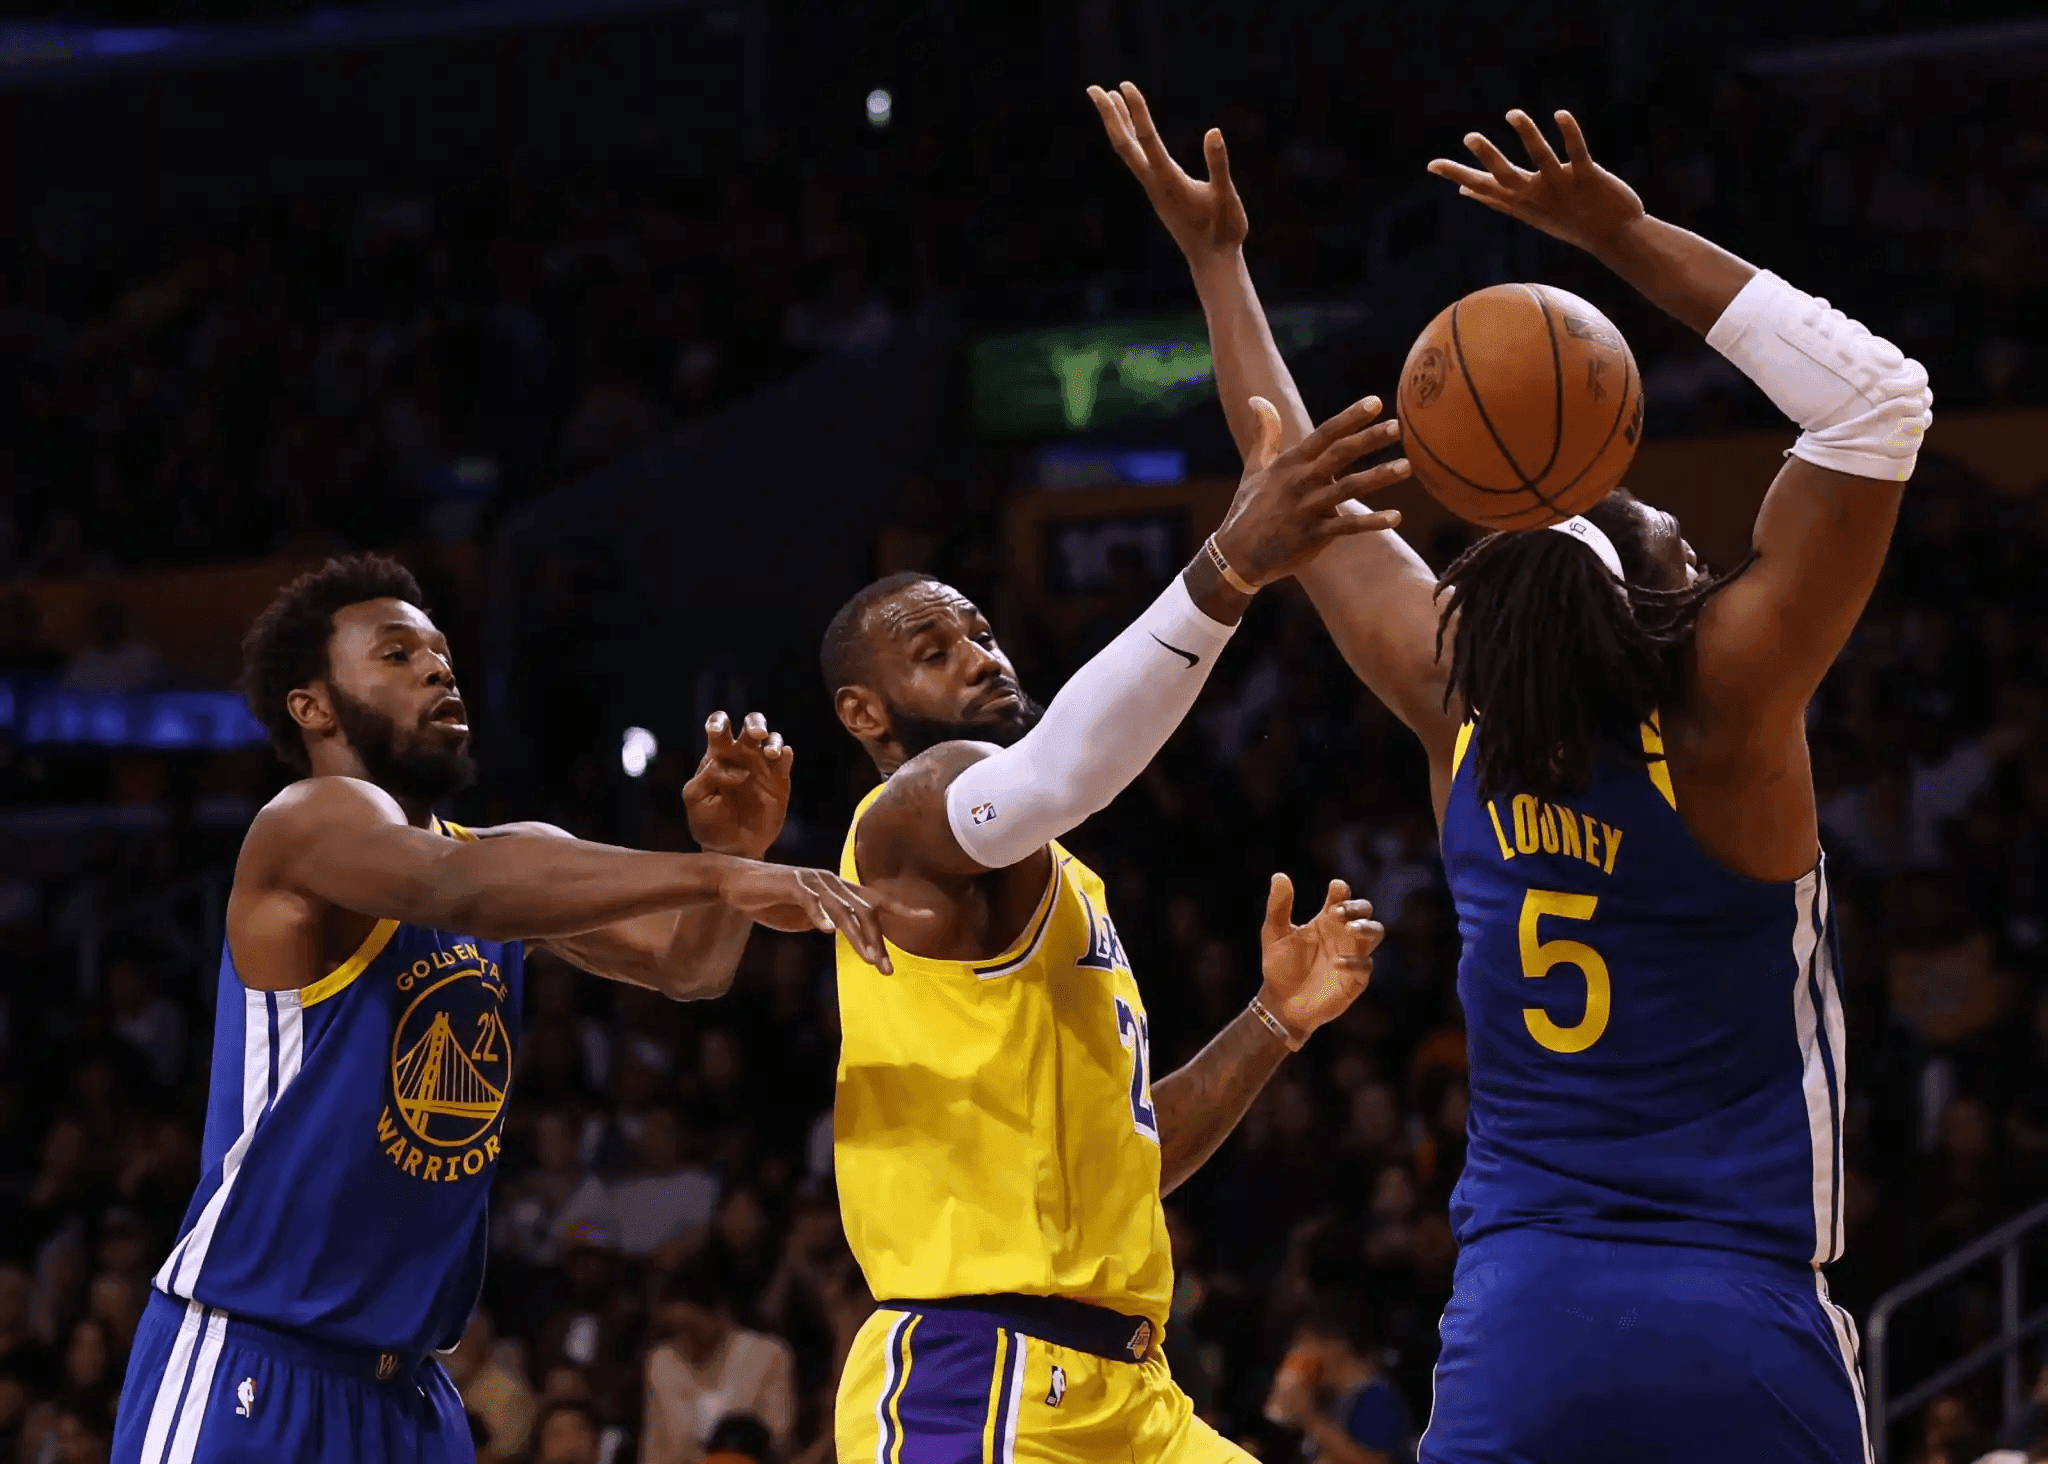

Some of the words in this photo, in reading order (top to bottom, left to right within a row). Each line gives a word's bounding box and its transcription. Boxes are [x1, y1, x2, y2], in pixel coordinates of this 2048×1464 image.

[1486, 793, 1624, 876] LOONEY
[396, 943, 479, 992] GOLDEN
[1518, 888, 1612, 1054] 5
[471, 1011, 499, 1063] 22
[1114, 997, 1160, 1147] 2
[376, 1104, 501, 1182] WARRIOR
